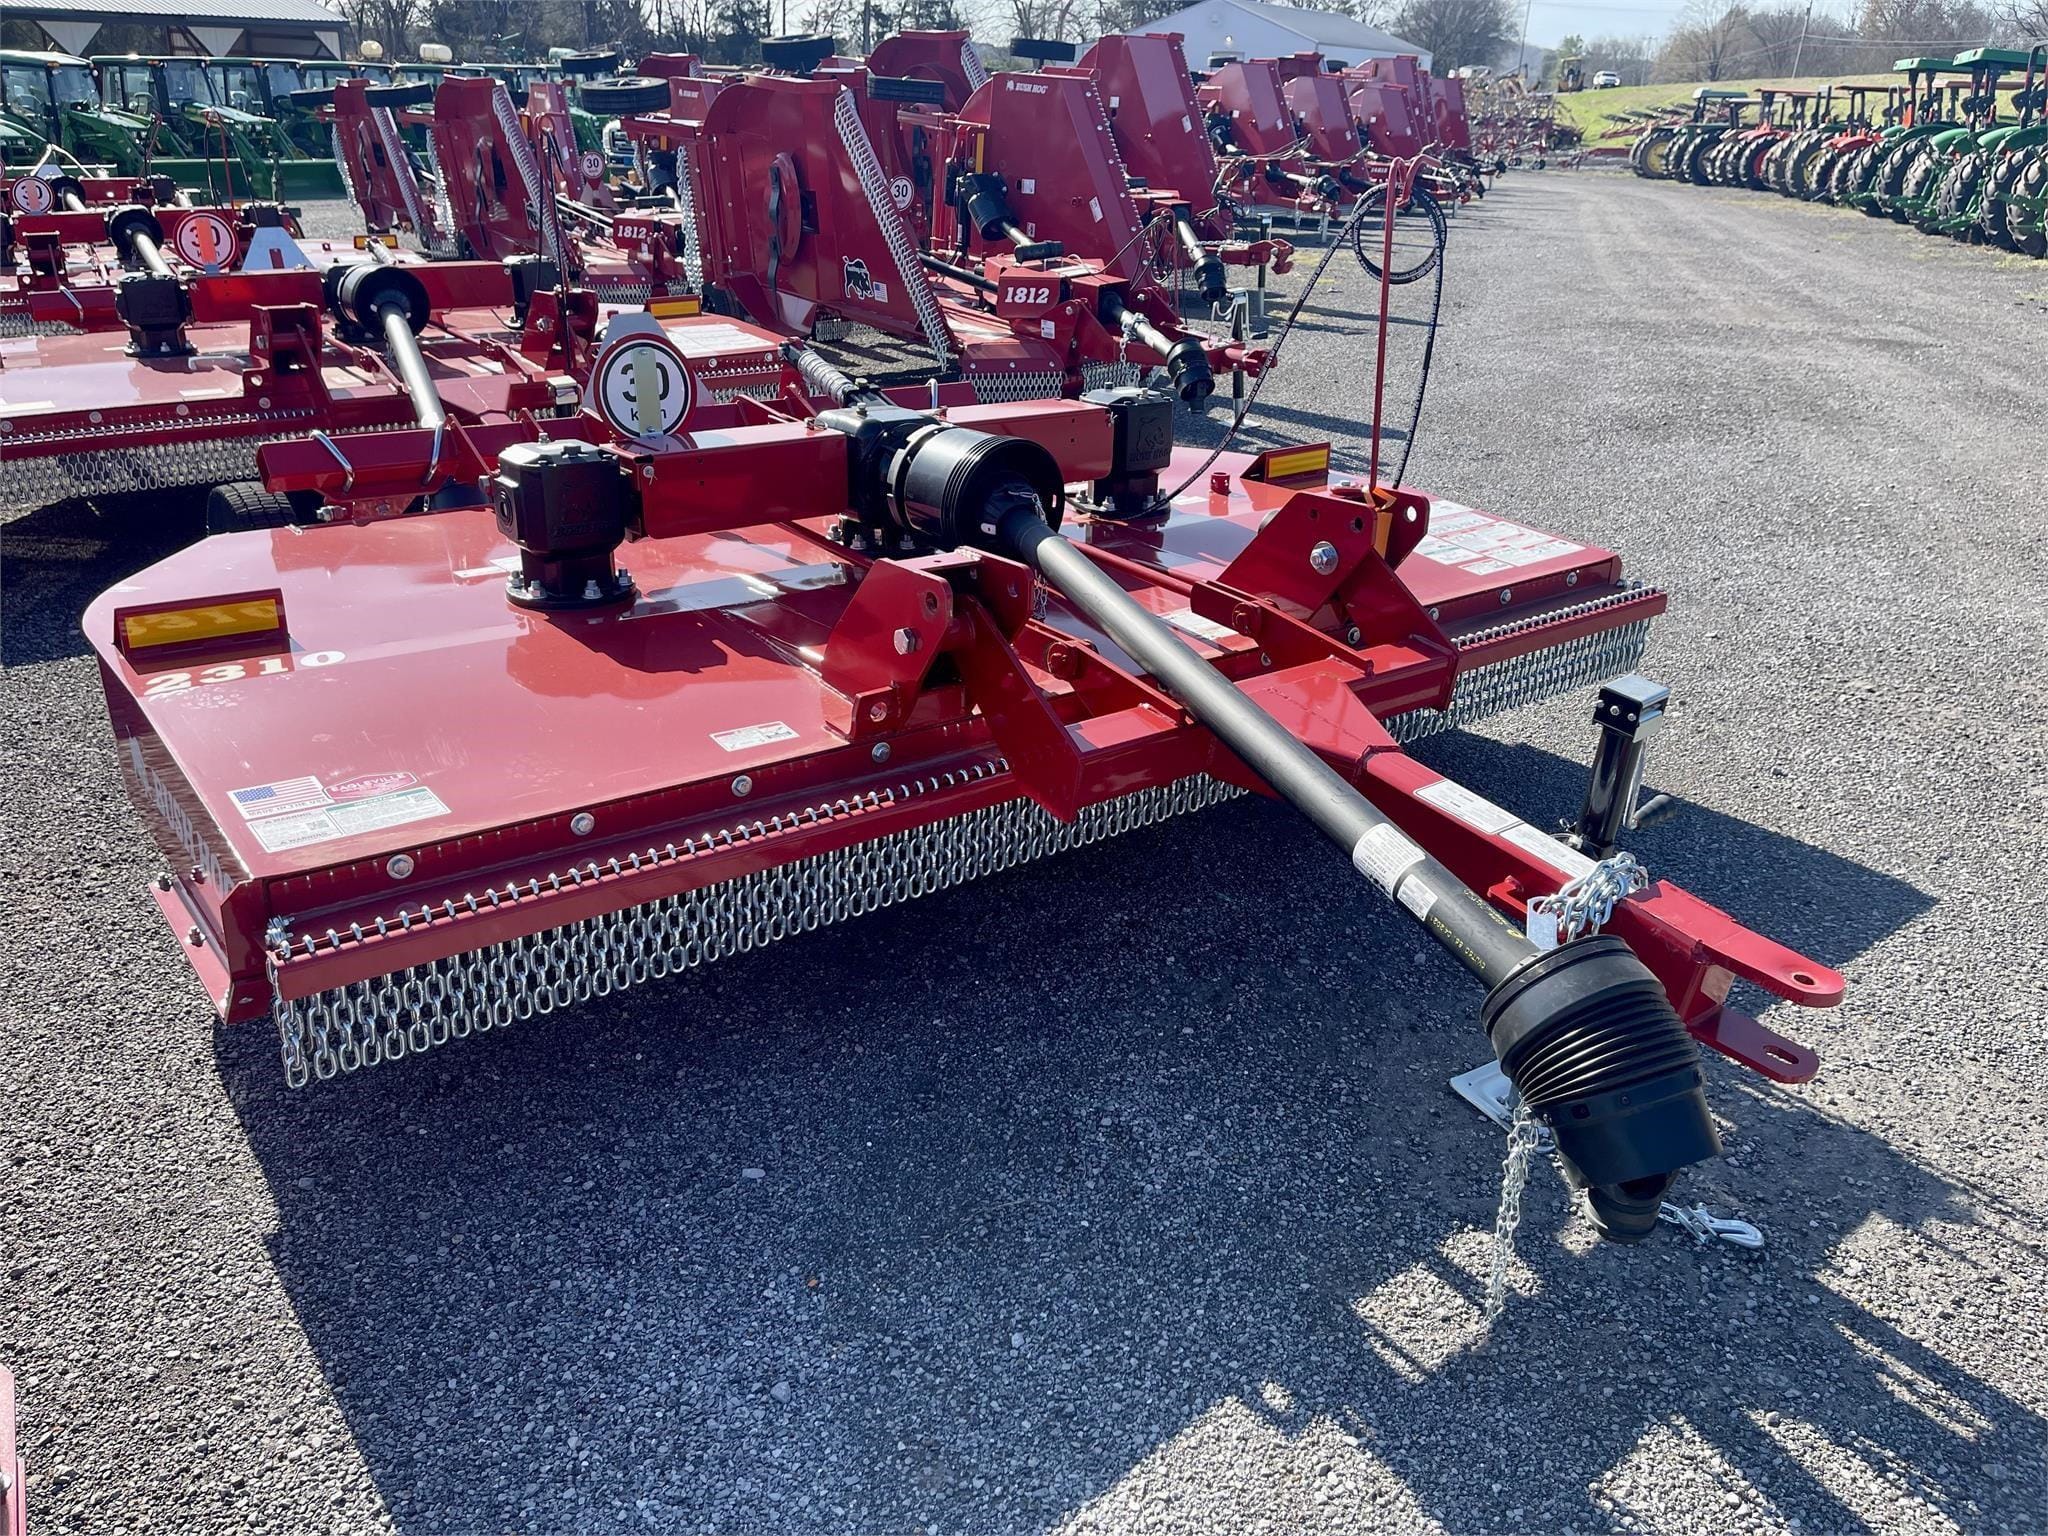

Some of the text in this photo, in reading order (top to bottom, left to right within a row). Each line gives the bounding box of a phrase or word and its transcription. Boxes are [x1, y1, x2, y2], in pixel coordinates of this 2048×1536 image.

[586, 157, 600, 169] 30
[893, 184, 908, 198] 30
[189, 225, 221, 248] 30
[617, 225, 647, 239] 1812
[1004, 286, 1050, 304] 1812
[620, 362, 670, 403] 30
[142, 650, 347, 697] 2310
